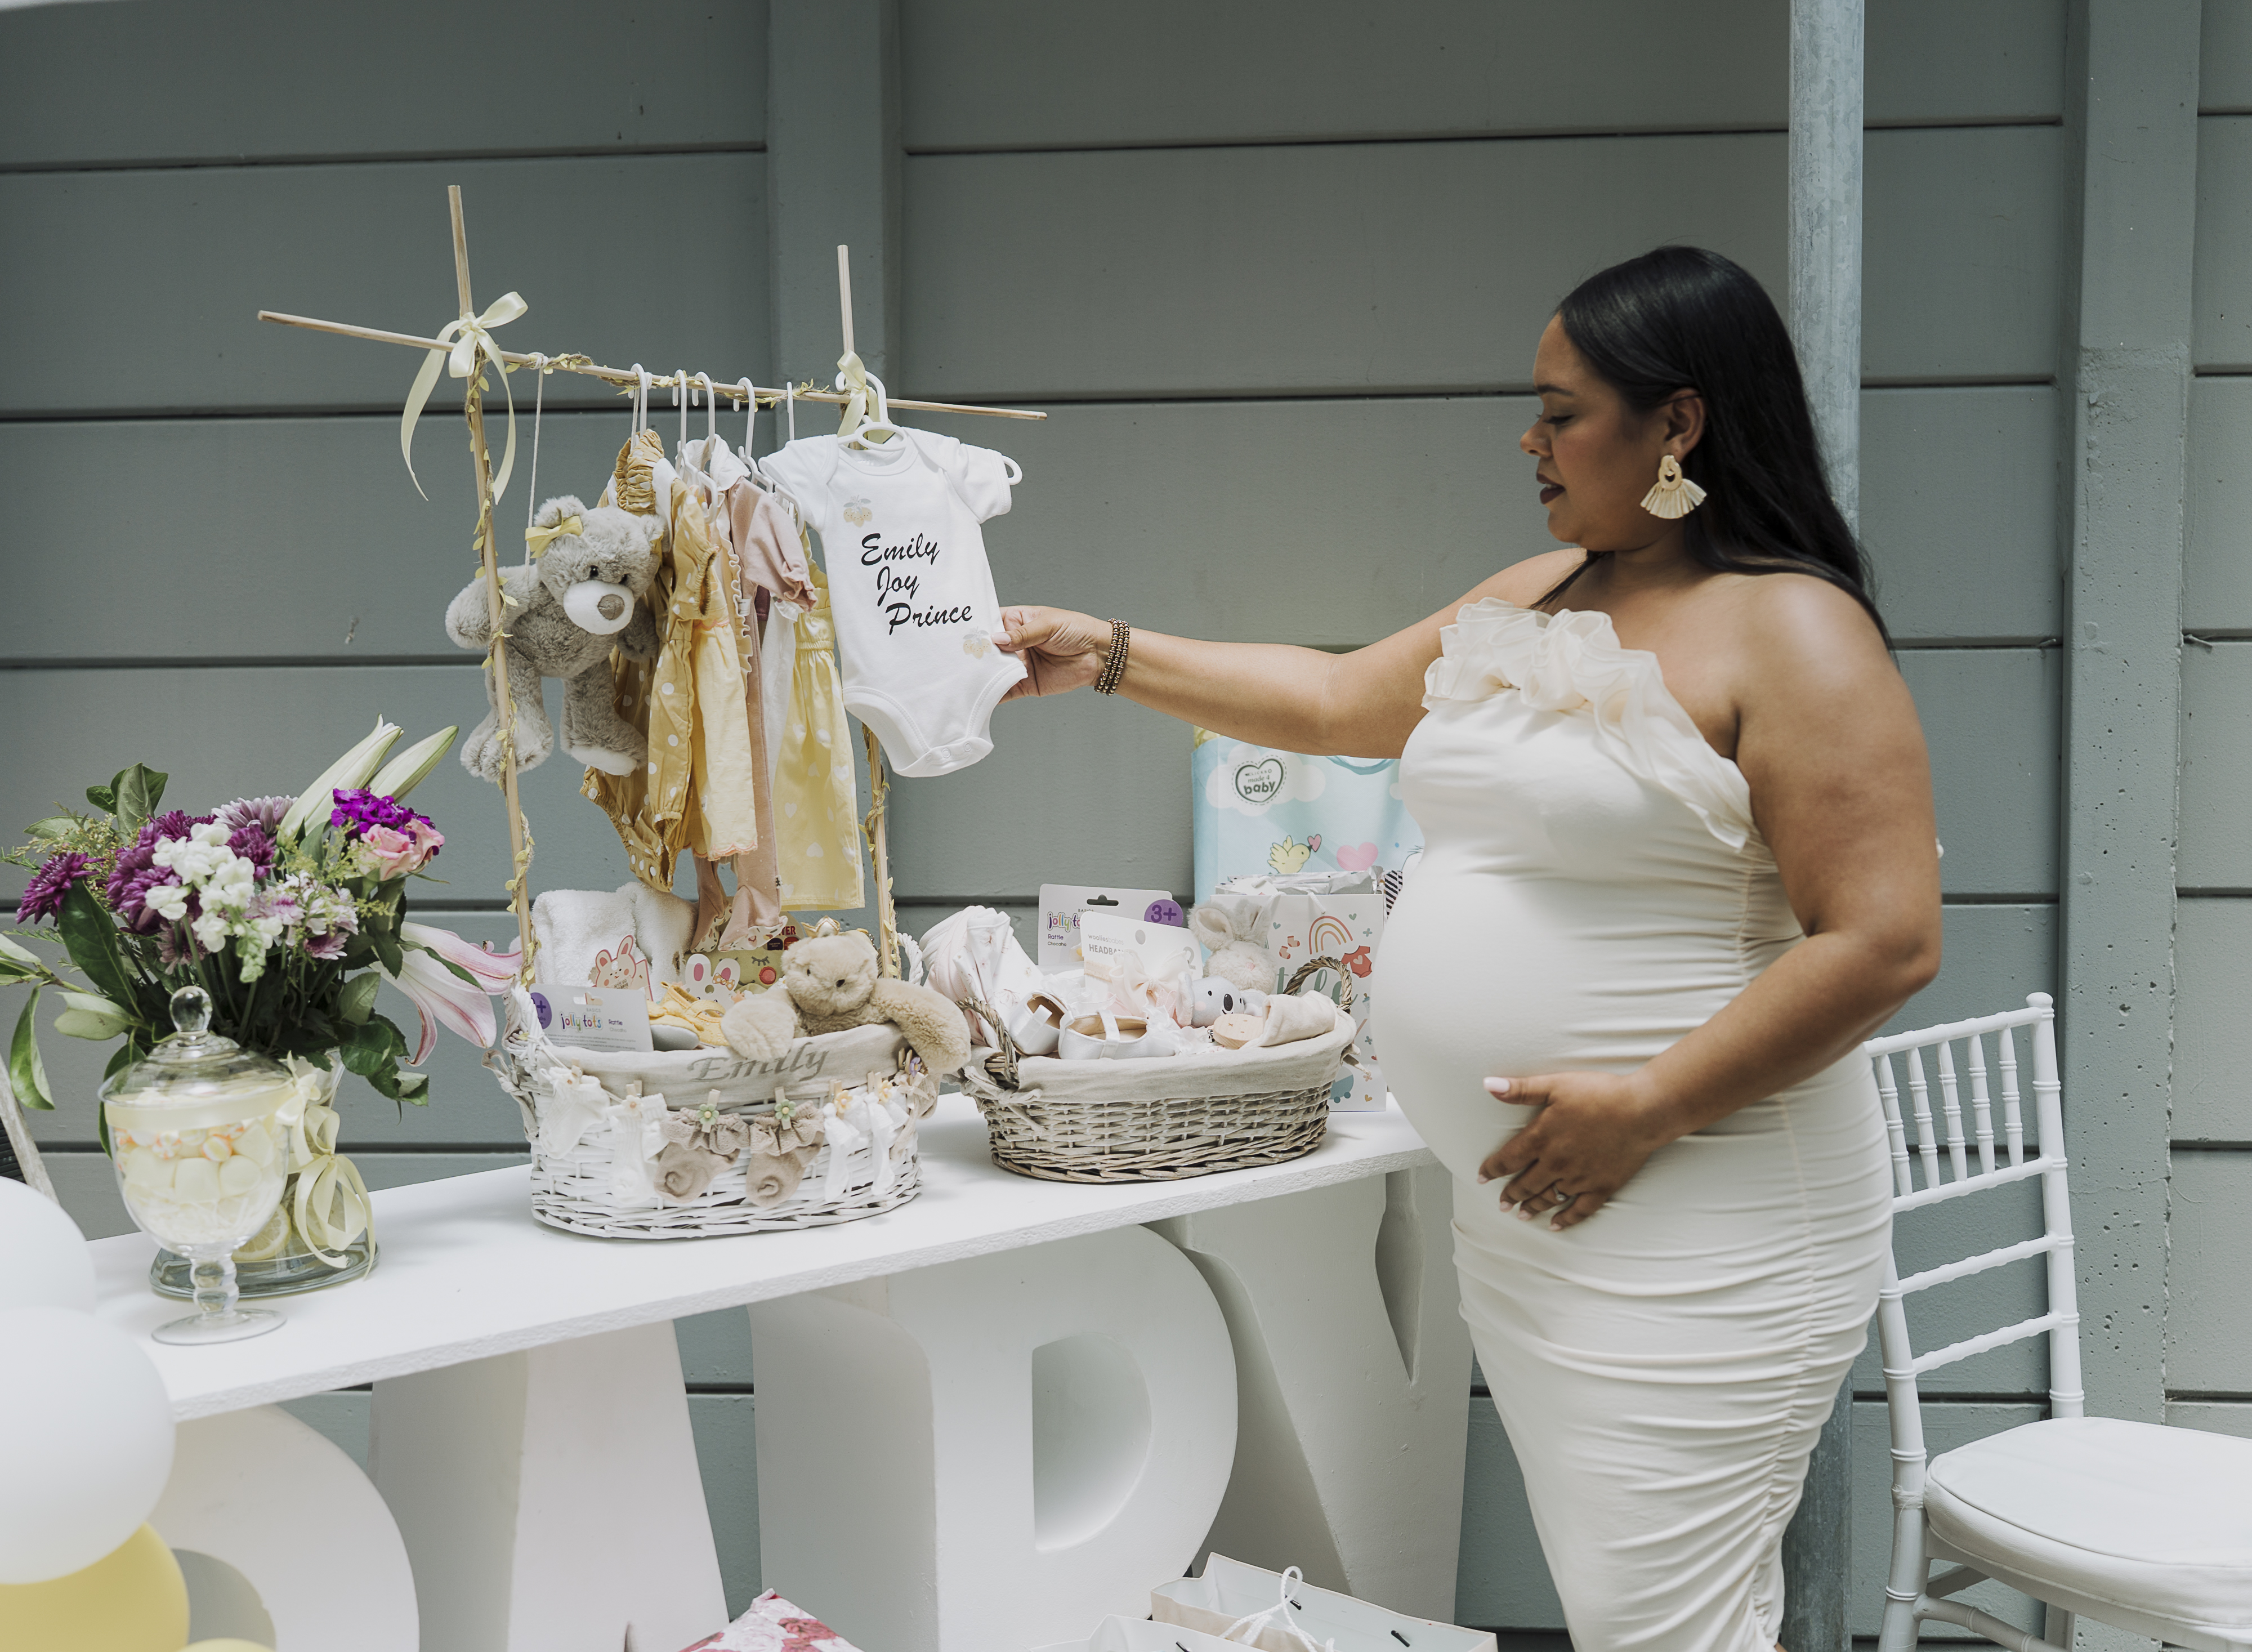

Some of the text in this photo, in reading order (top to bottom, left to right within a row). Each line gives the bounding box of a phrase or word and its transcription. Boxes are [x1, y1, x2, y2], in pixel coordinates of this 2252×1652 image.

[861, 533, 940, 566] Emily
[877, 566, 920, 607] Joy
[885, 602, 973, 636] Prince
[1244, 781, 1276, 795] baby
[1049, 913, 1070, 931] jolly
[1151, 904, 1177, 922] 3+
[1088, 934, 1124, 945] wooliesbabes
[561, 1013, 602, 1031] jolly tots
[687, 1042, 829, 1082] Emily
